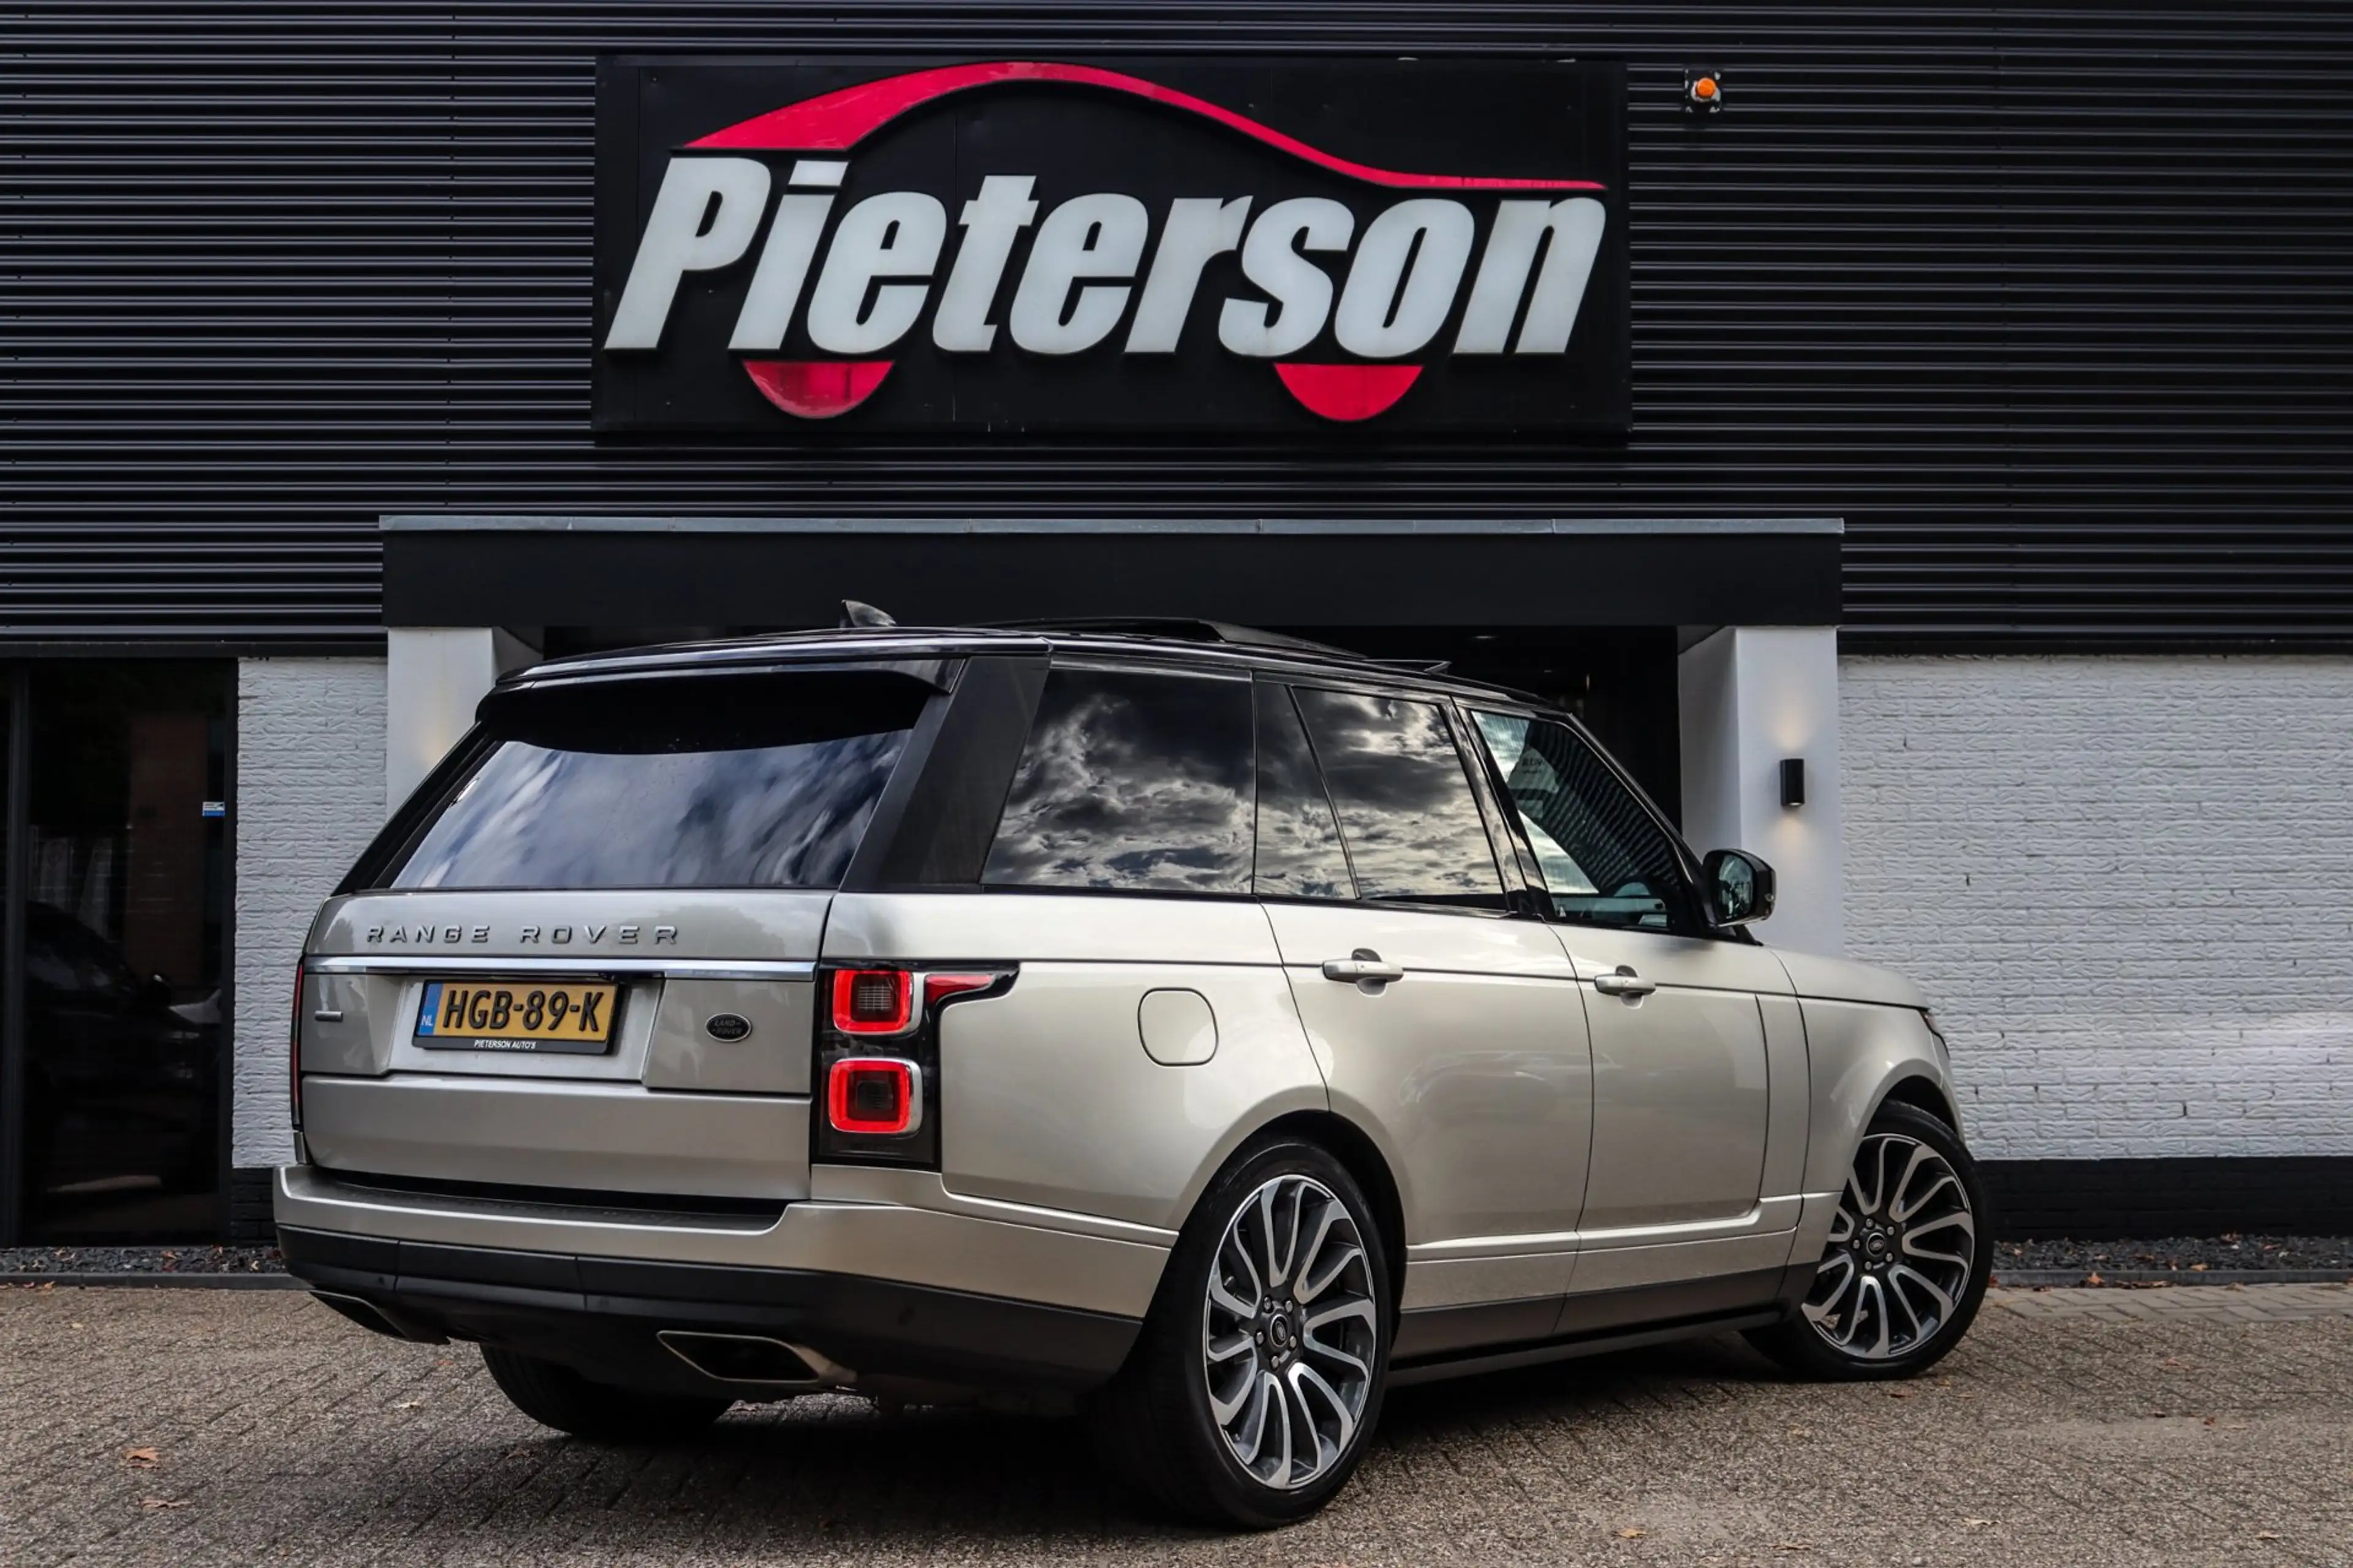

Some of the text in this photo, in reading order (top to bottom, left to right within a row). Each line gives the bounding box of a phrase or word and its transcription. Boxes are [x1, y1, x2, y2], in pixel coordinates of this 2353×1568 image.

[604, 157, 1606, 358] Pieterson
[366, 924, 678, 945] RANGE ROVER
[421, 1014, 433, 1026] NL
[442, 989, 605, 1032] HGB-89-K
[474, 1039, 510, 1049] PIETERSON
